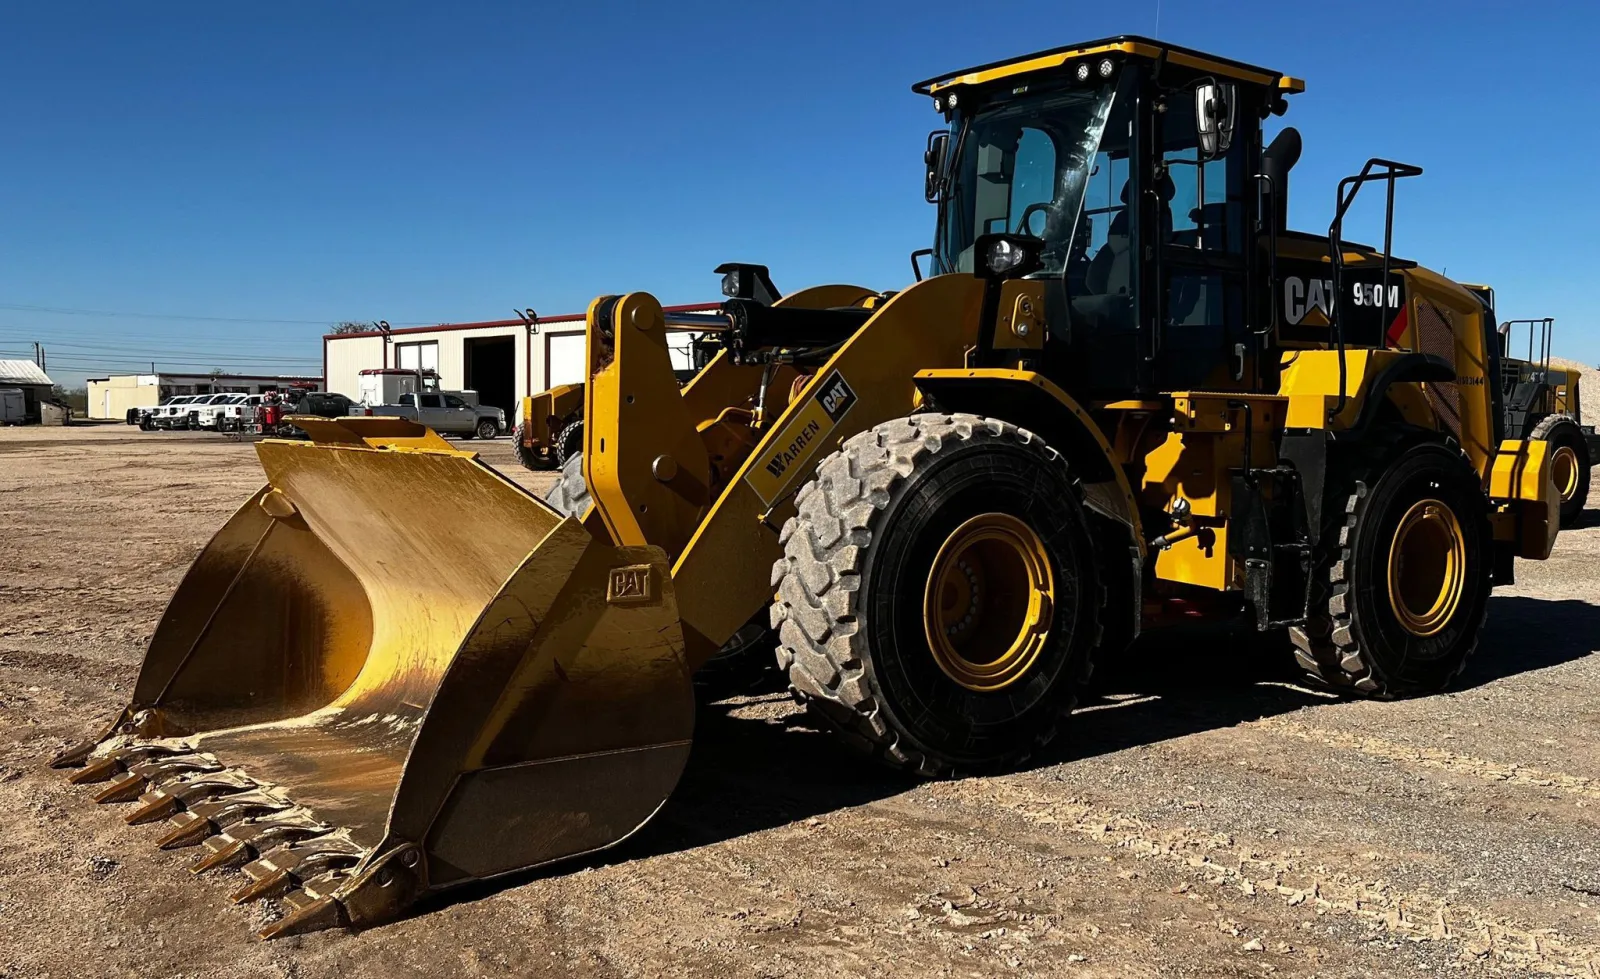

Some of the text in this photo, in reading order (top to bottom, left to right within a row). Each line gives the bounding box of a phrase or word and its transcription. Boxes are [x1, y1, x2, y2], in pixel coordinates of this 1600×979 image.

[766, 382, 848, 478] WARREN CAT
[614, 570, 650, 597] CAT
